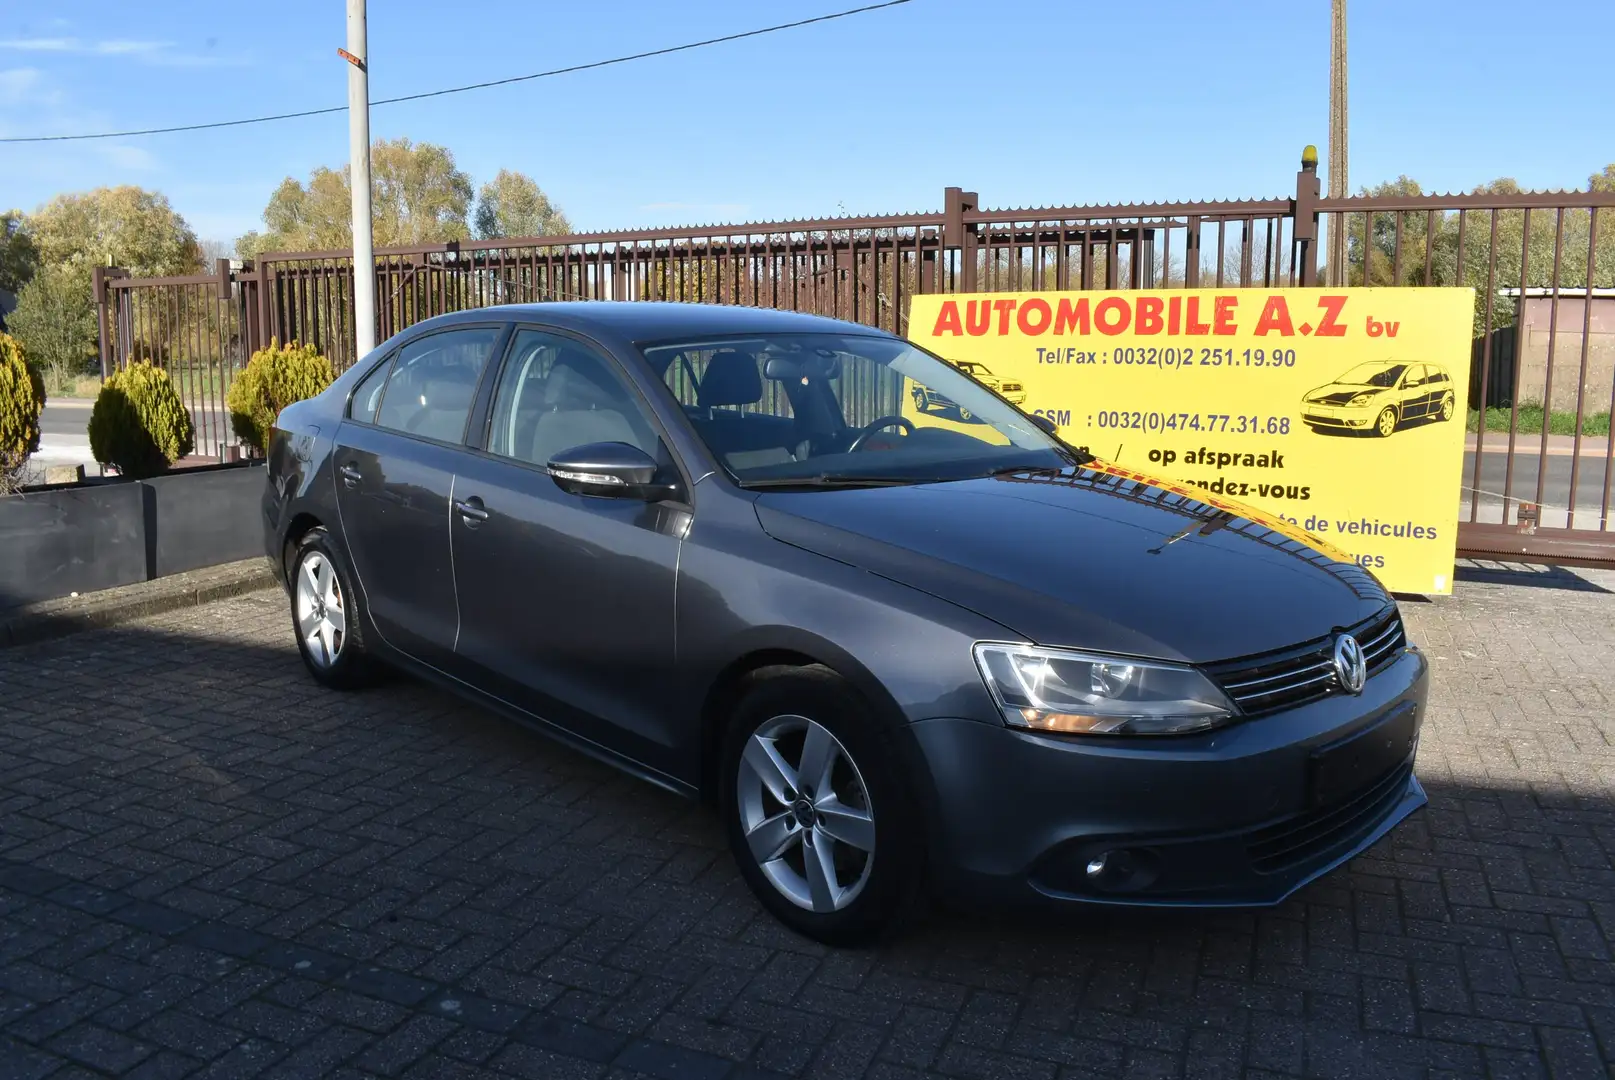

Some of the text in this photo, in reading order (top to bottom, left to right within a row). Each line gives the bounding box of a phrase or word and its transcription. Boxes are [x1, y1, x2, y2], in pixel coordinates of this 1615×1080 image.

[932, 295, 1400, 338] AUTOMOBILE A.Z bv
[1036, 347, 1097, 364] Tel/Fax
[1113, 347, 1194, 369] 0032(0)2
[1199, 348, 1296, 367] 251.19.90
[1098, 411, 1291, 435] 0032(0)474.77.31.68
[1148, 449, 1177, 466] op
[1184, 447, 1285, 469] afspraak
[1304, 515, 1329, 532] de
[1336, 518, 1438, 540] vehicules
